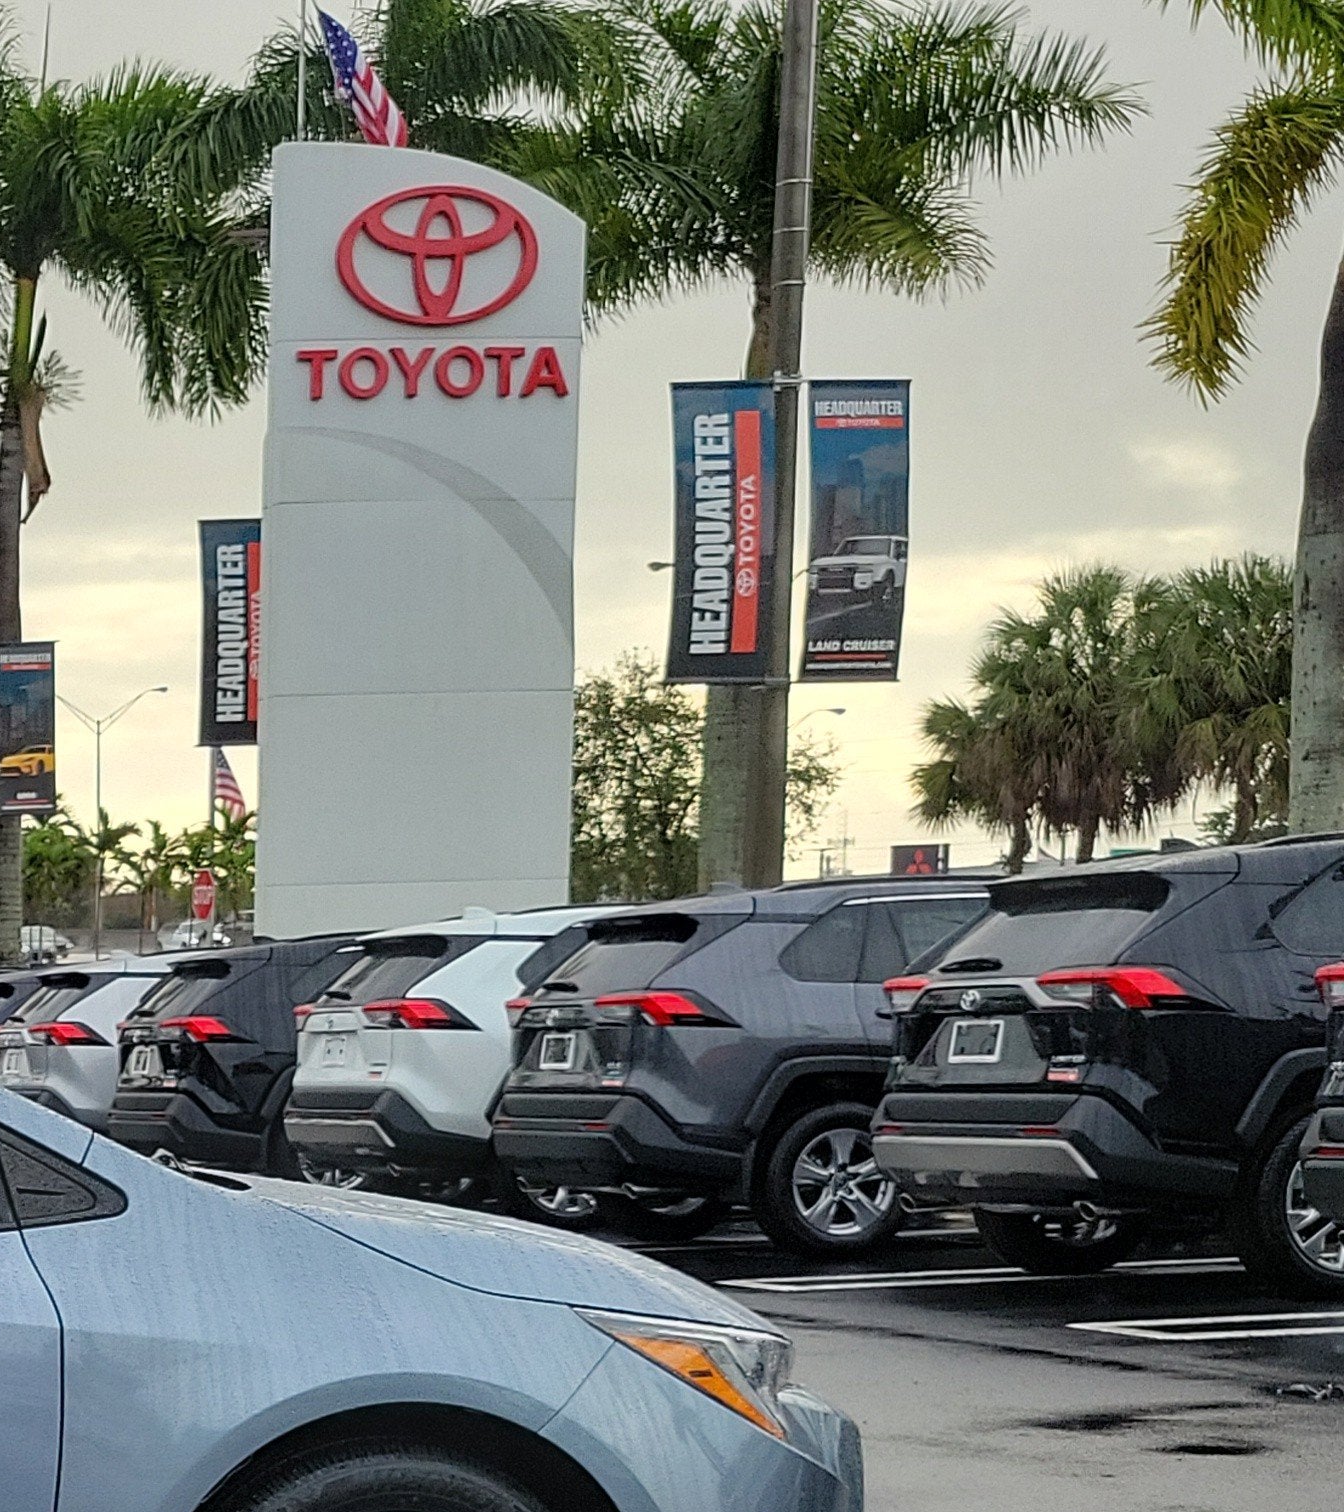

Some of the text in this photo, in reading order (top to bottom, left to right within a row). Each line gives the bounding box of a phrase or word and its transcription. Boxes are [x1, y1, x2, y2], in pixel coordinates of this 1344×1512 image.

[296, 346, 569, 401] TOYOTA
[814, 400, 903, 418] HEADQUARTER
[689, 412, 735, 655] HEADQUARTER
[738, 473, 757, 567] TOYOTA
[215, 543, 249, 723] HEADQUARTER
[808, 639, 896, 651] LAND CRUISER
